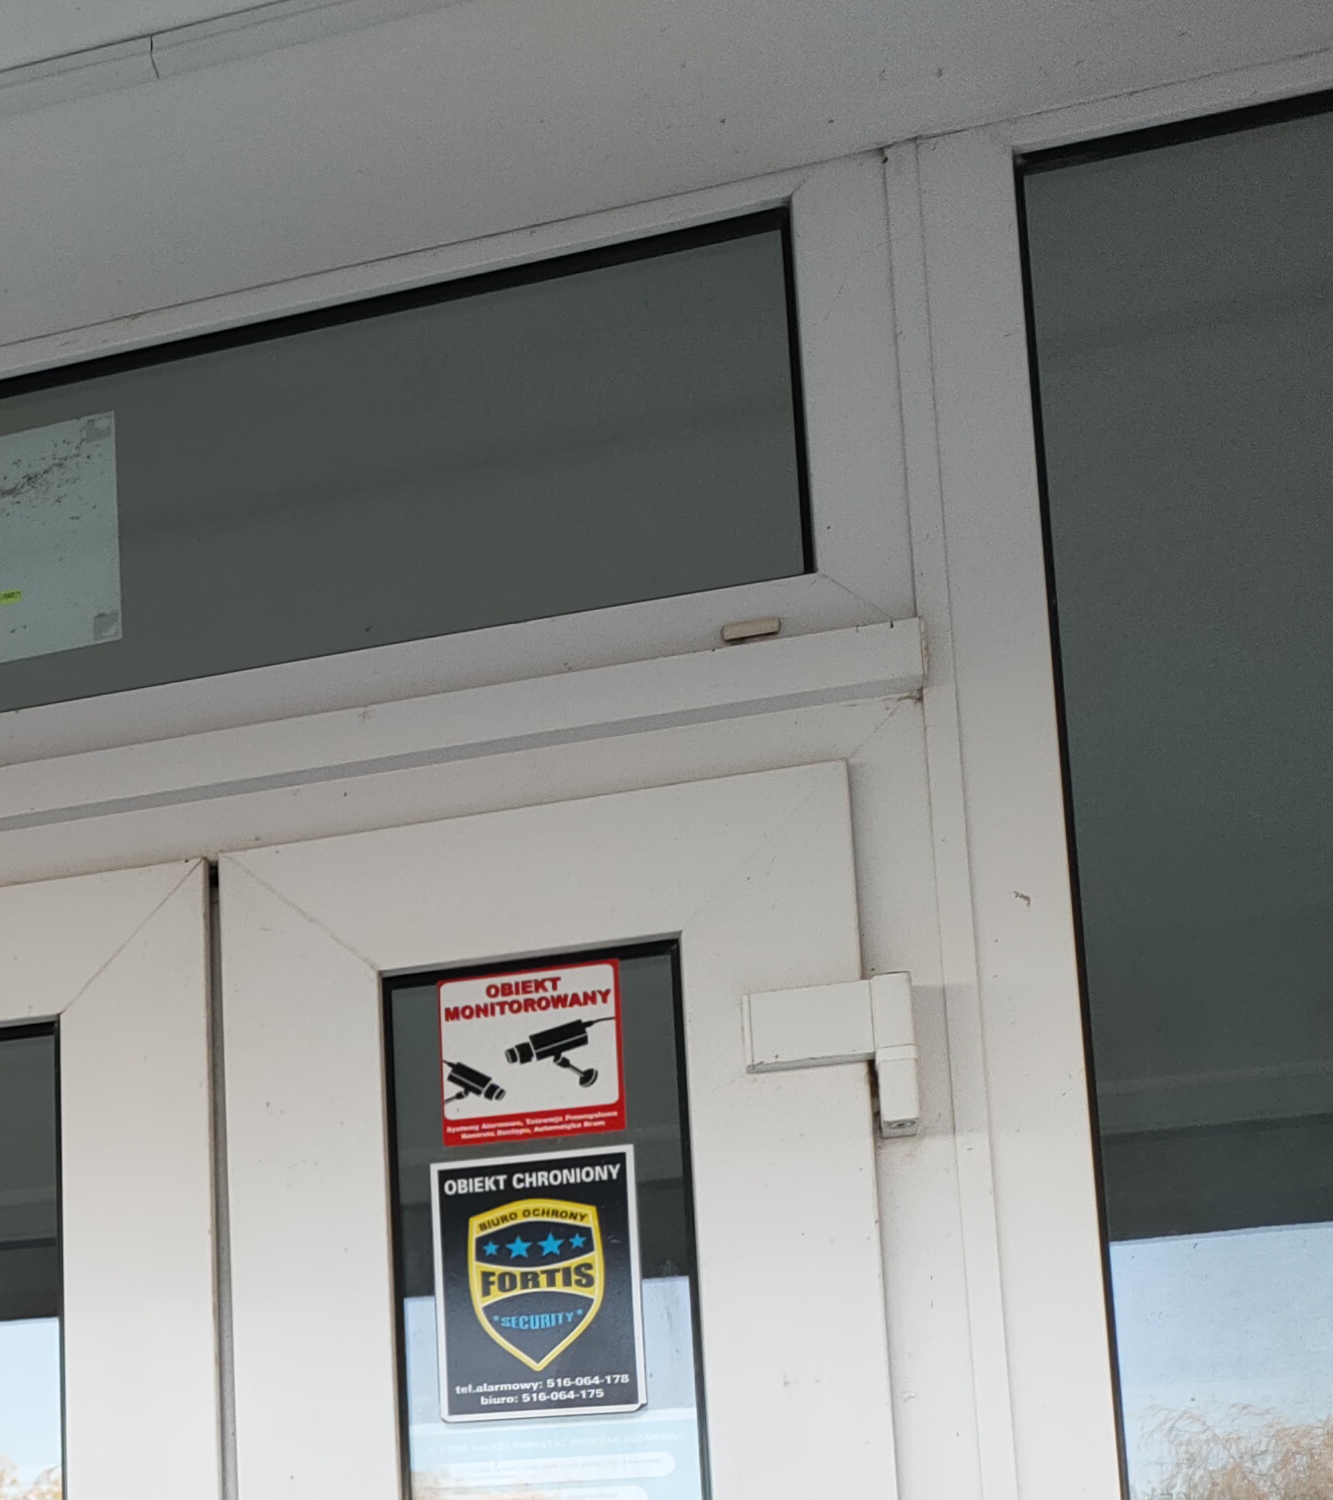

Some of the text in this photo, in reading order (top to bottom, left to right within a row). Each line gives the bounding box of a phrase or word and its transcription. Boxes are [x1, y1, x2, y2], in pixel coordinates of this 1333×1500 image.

[486, 977, 561, 998] OBIEKT
[444, 988, 612, 1021] MONITOROWANY
[443, 1164, 621, 1195] OBIEKT CHRONIONY
[478, 1208, 590, 1232] BIURO OCHRONY
[480, 1262, 595, 1298] FORTIS
[500, 1311, 574, 1330] SECURITY
[455, 1373, 629, 1395] tel.alarmowy: 516-064-178
[480, 1388, 604, 1406] biuro: 516-064-175
